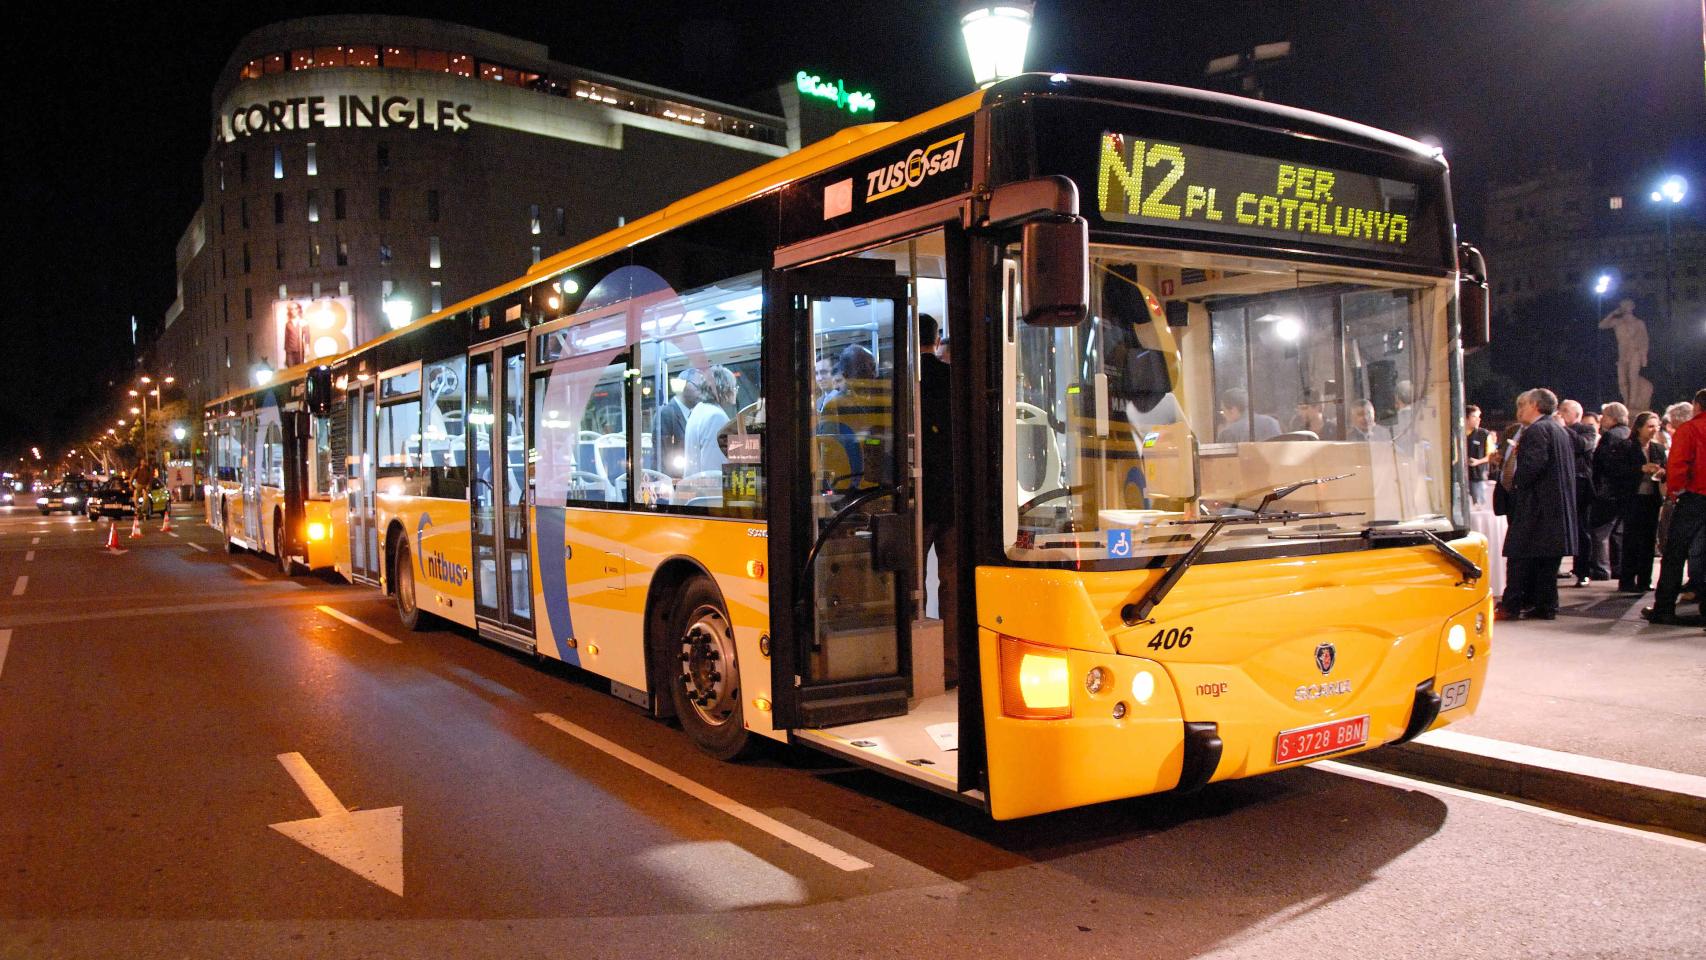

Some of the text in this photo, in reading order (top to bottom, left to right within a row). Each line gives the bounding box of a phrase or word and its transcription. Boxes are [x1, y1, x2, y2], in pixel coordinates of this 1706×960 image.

[232, 95, 325, 138] CORTE
[338, 94, 473, 134] INGLES
[1098, 135, 1185, 221] N2
[1276, 164, 1336, 202] PER
[1185, 185, 1408, 244] PL CATALUNYA
[428, 550, 463, 587] nitbus
[1147, 626, 1194, 651] 406
[1196, 681, 1228, 698] noge
[1294, 679, 1353, 702] SCANIA
[1444, 683, 1467, 708] SP
[1280, 739, 1289, 757] S
[1297, 729, 1330, 754] 3728
[1337, 722, 1362, 744] BBN
